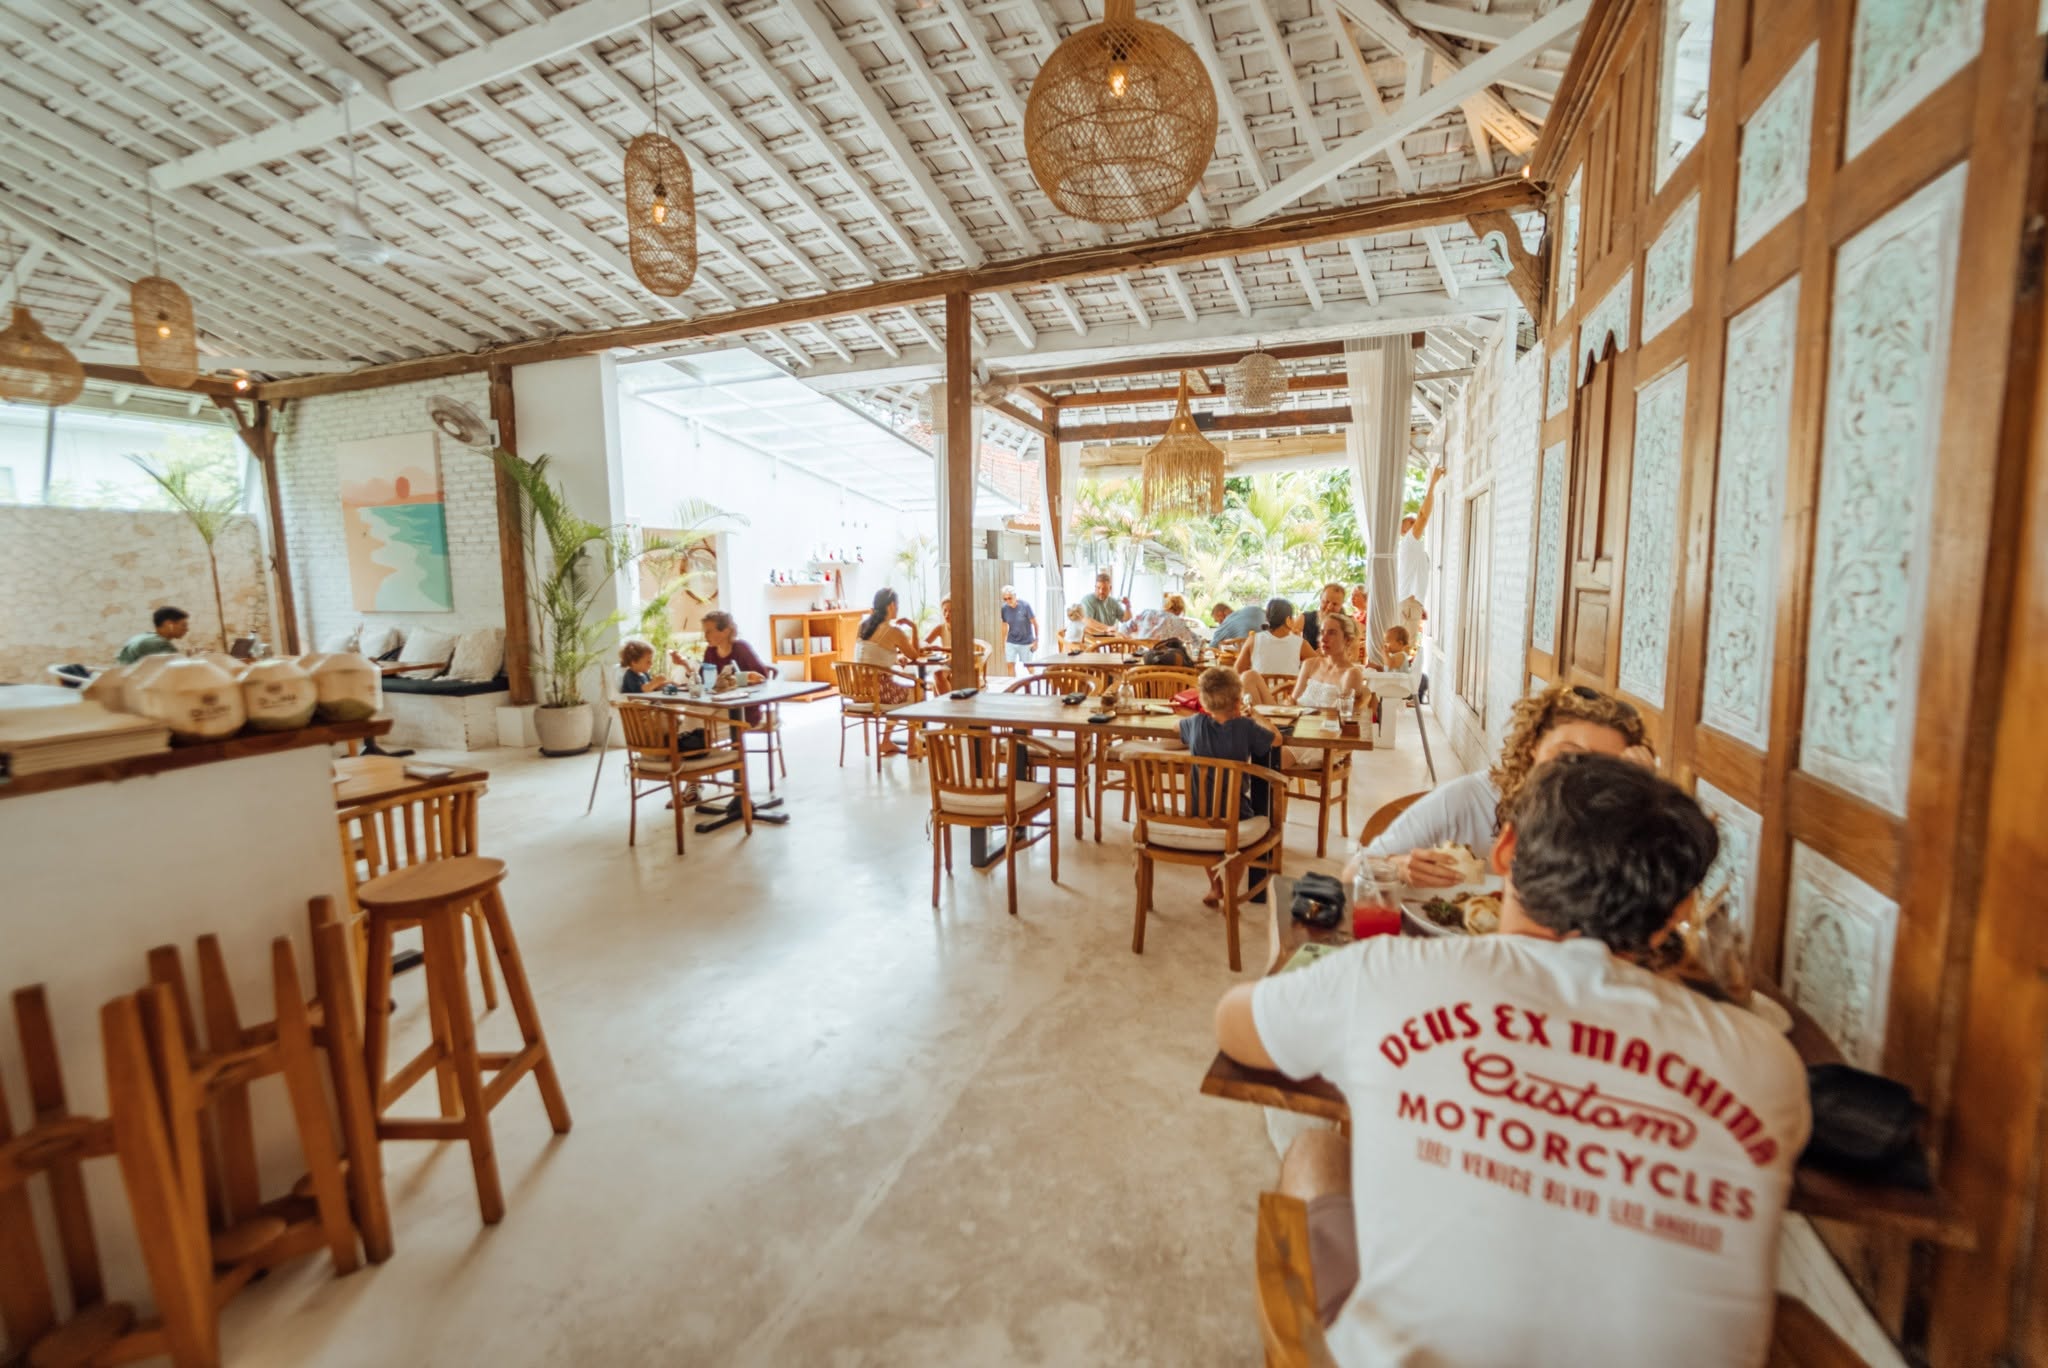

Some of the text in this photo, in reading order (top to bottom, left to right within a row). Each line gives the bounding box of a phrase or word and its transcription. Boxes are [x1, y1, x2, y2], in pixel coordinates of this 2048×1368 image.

[1379, 1002, 1780, 1167] DEUS EX MACHINA
[1462, 1046, 1698, 1150] Custom
[1398, 1091, 1754, 1221] MOTORCYCLES
[1461, 1150, 1533, 1197] VENICE
